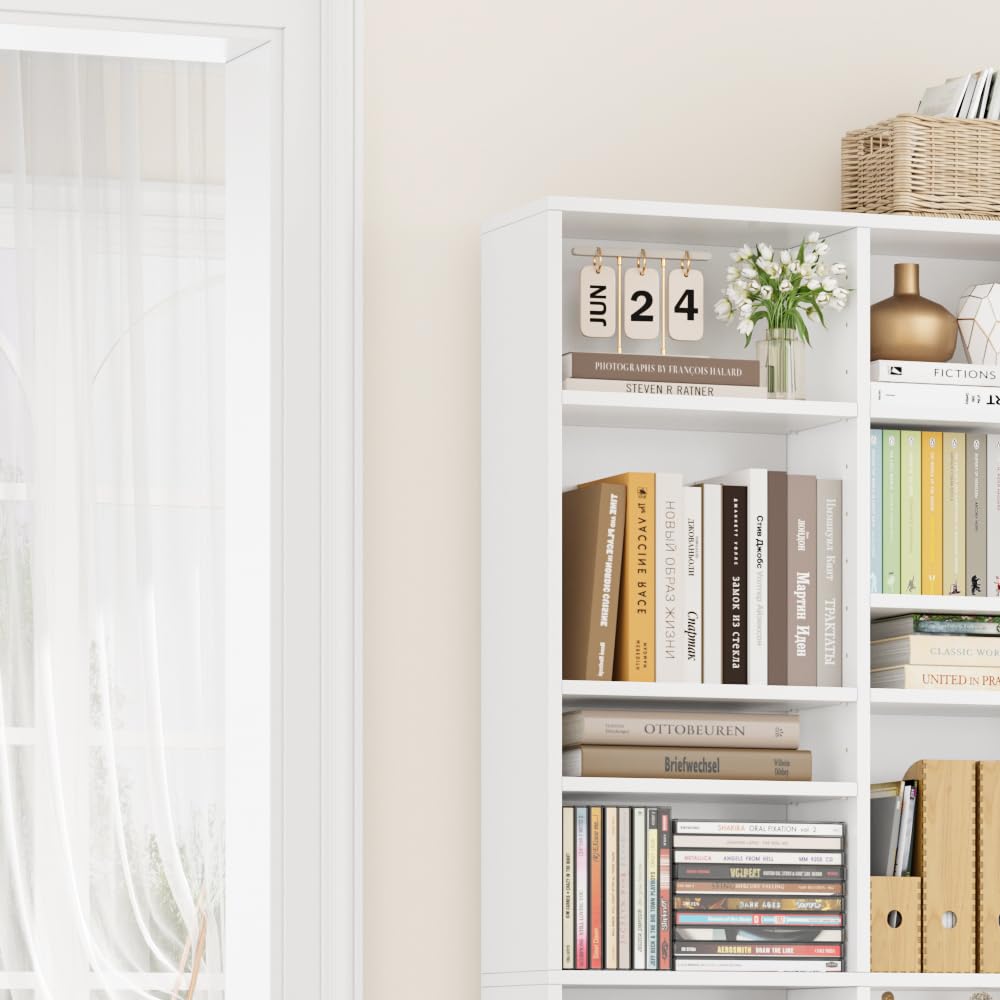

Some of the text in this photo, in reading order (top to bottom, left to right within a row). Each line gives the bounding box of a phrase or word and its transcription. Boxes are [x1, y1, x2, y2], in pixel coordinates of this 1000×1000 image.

[590, 284, 606, 326] JUN
[630, 290, 654, 322] 2
[674, 289, 698, 320] 4
[595, 361, 742, 377] PHOTOGRAPHS BY FRANÇOIS HALARD
[934, 367, 996, 380] FICTIONS
[626, 383, 714, 397] STEVEN R RATNER
[755, 515, 764, 569] Стив Джобс
[665, 501, 677, 659] НОВЫЙ ОБРАЗ ЖИЗНИ
[732, 614, 739, 627] из
[794, 572, 810, 657] Мартин Иден
[684, 611, 698, 661] Спартак
[824, 598, 836, 665] ТРАКТАТЫ
[732, 631, 740, 669] стекла
[930, 647, 974, 657] CLASSIC
[922, 674, 967, 685] UNITED
[970, 677, 980, 686] IN
[644, 723, 746, 737] OTTOBEUREN
[664, 756, 720, 773] Briefwechsel
